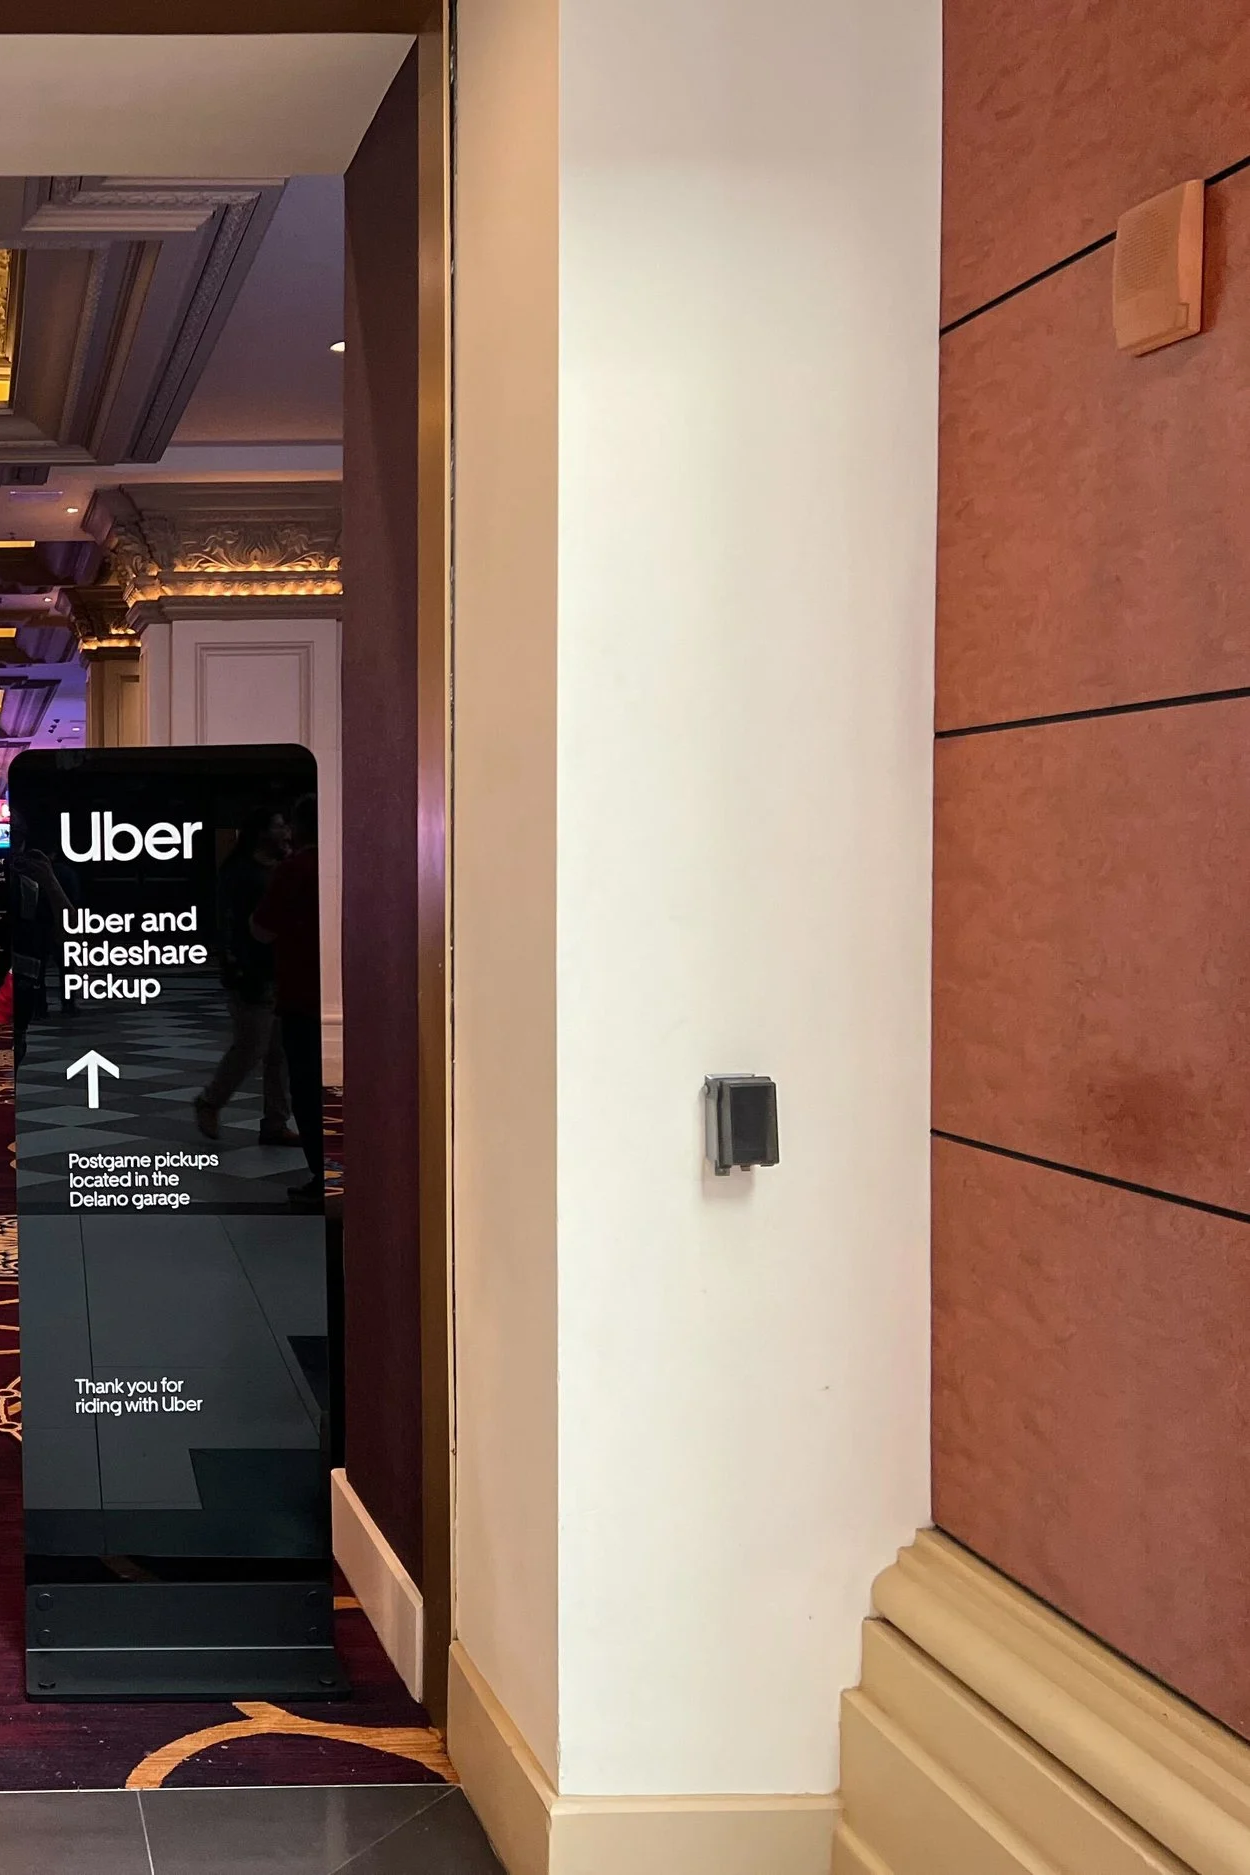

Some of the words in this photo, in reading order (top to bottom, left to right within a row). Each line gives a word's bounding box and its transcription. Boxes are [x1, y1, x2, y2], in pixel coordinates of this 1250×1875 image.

[60, 811, 203, 863] Uber
[62, 908, 135, 935] Uber
[140, 905, 197, 933] and
[63, 939, 208, 967] Rideshare
[64, 973, 161, 1005] Pickup
[68, 1153, 152, 1172] Postgame
[154, 1151, 219, 1172] pickups
[69, 1172, 132, 1189] located
[134, 1172, 149, 1187] in
[151, 1170, 180, 1187] the
[69, 1190, 129, 1208] Delano
[131, 1192, 191, 1210] garage
[74, 1378, 125, 1395] Thank
[126, 1380, 158, 1397] you
[160, 1376, 184, 1393] for
[75, 1397, 122, 1417] riding
[124, 1396, 159, 1413] with
[161, 1395, 204, 1412] Uber
